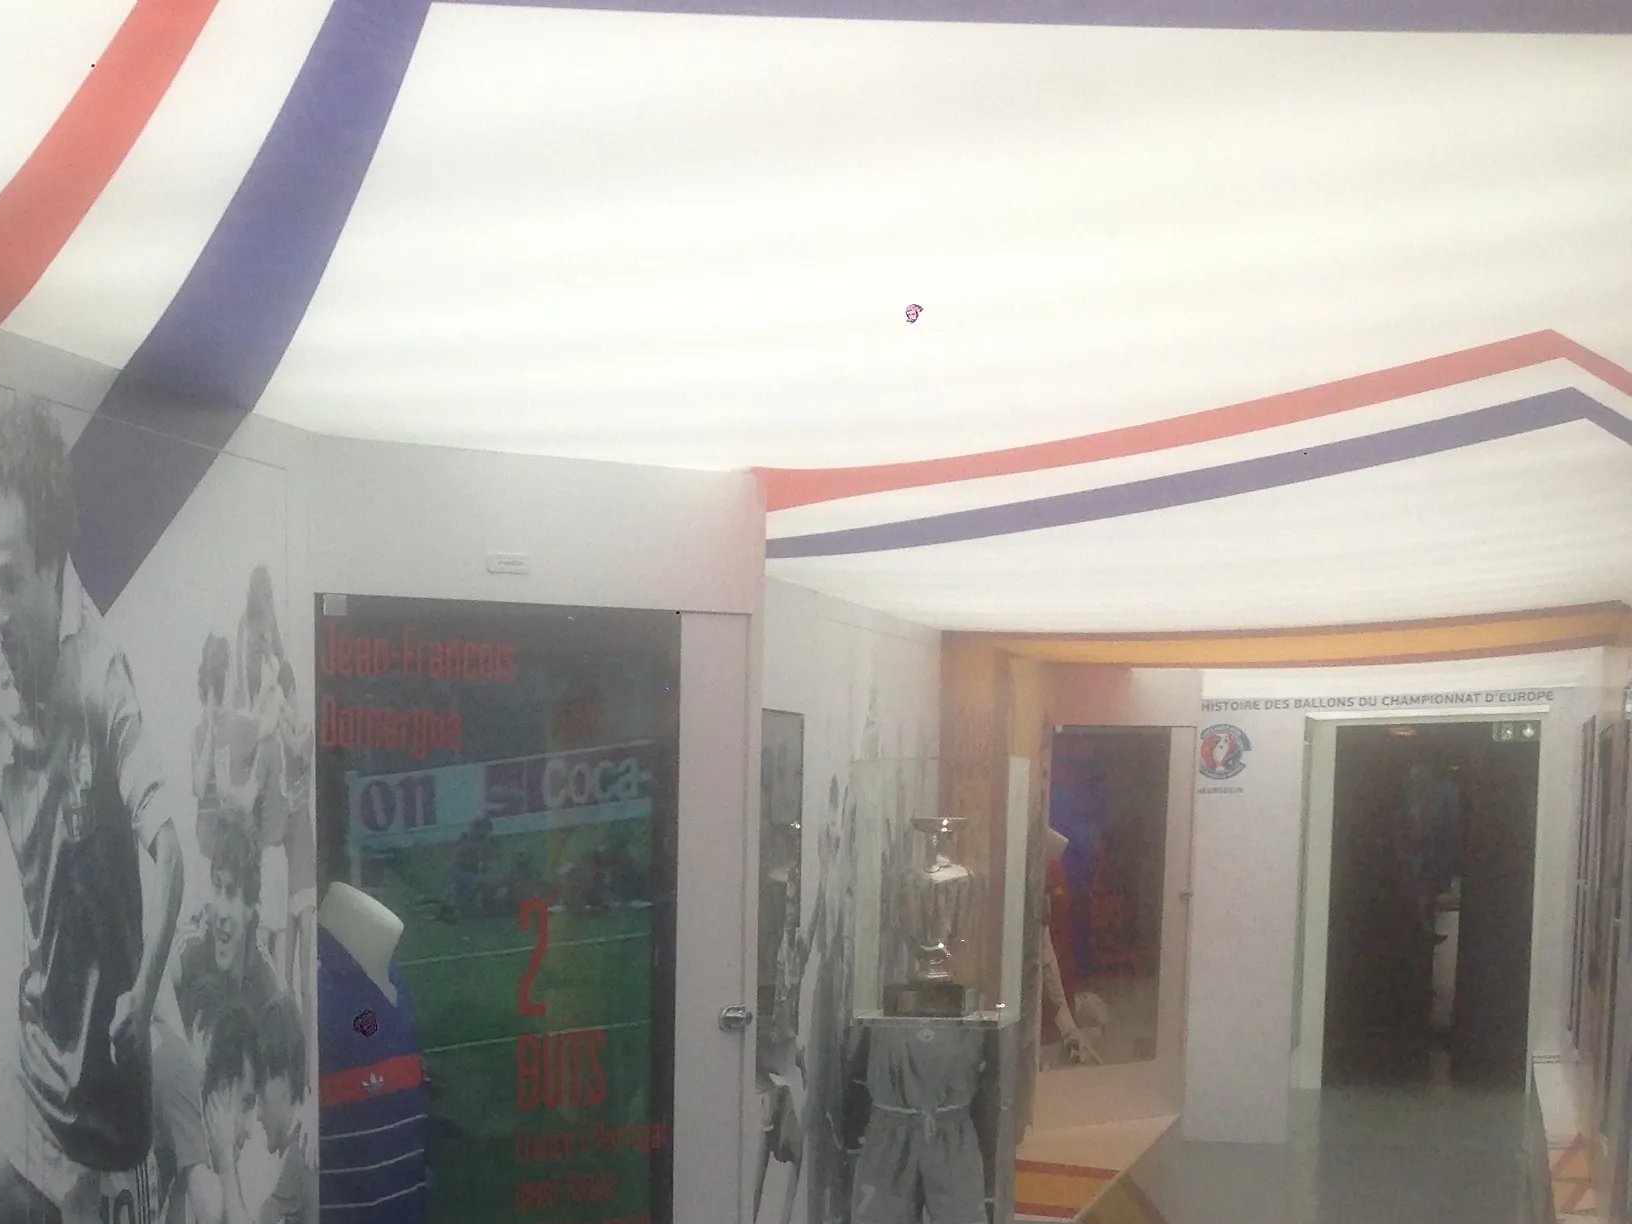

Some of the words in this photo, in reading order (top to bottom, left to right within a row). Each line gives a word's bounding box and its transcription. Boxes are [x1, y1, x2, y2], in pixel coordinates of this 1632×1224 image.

[1201, 699, 1261, 713] HISTOIRE
[1264, 698, 1290, 711] DES
[1294, 696, 1355, 710] BALLONS
[1358, 695, 1378, 708] DU
[1381, 692, 1482, 707] CHAMPIONNAT
[1485, 690, 1554, 704] D'EUROPE
[518, 898, 549, 1017] 2
[516, 1029, 608, 1111] BUTS
